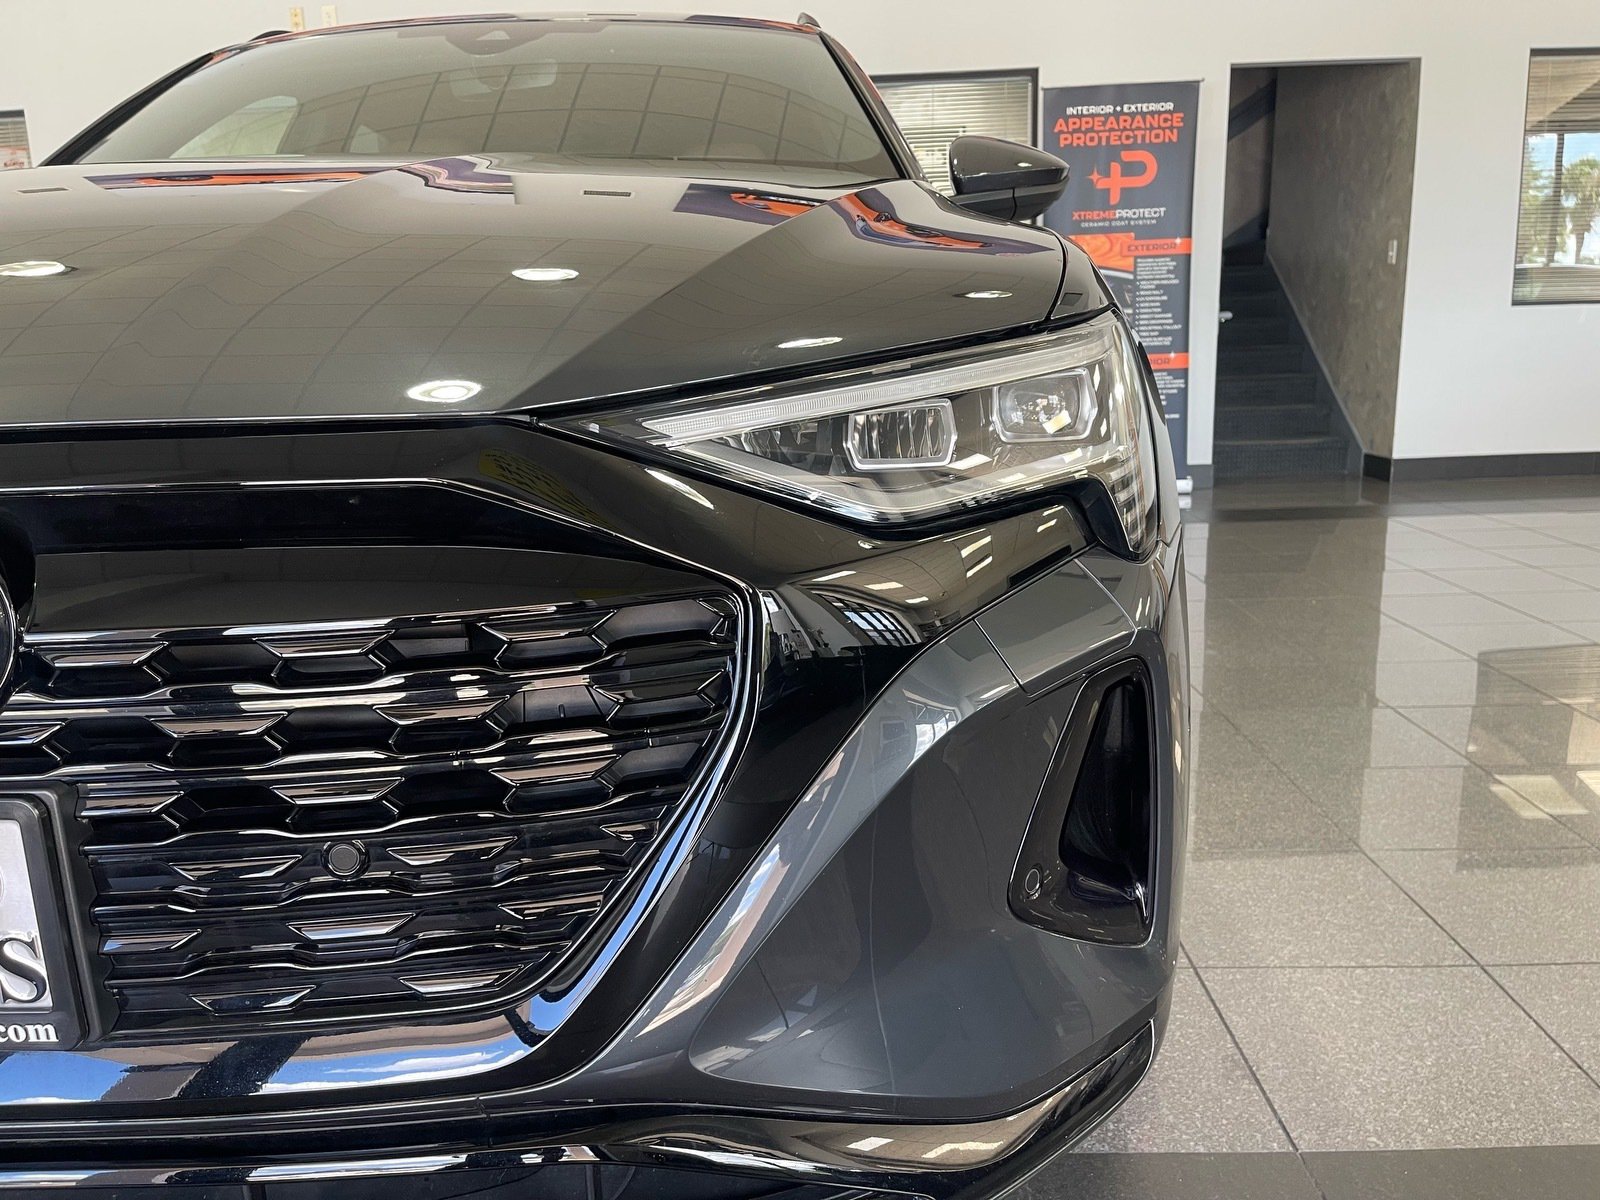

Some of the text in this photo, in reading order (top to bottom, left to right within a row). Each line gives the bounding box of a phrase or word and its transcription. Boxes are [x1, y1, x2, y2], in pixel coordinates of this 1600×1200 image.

[1066, 105, 1114, 115] INTERIOR
[1123, 102, 1175, 113] EXTERIOR
[1054, 113, 1185, 132] APPEARANCE
[1060, 129, 1179, 147] PROTECTION
[1127, 242, 1177, 252] EXTERIOR
